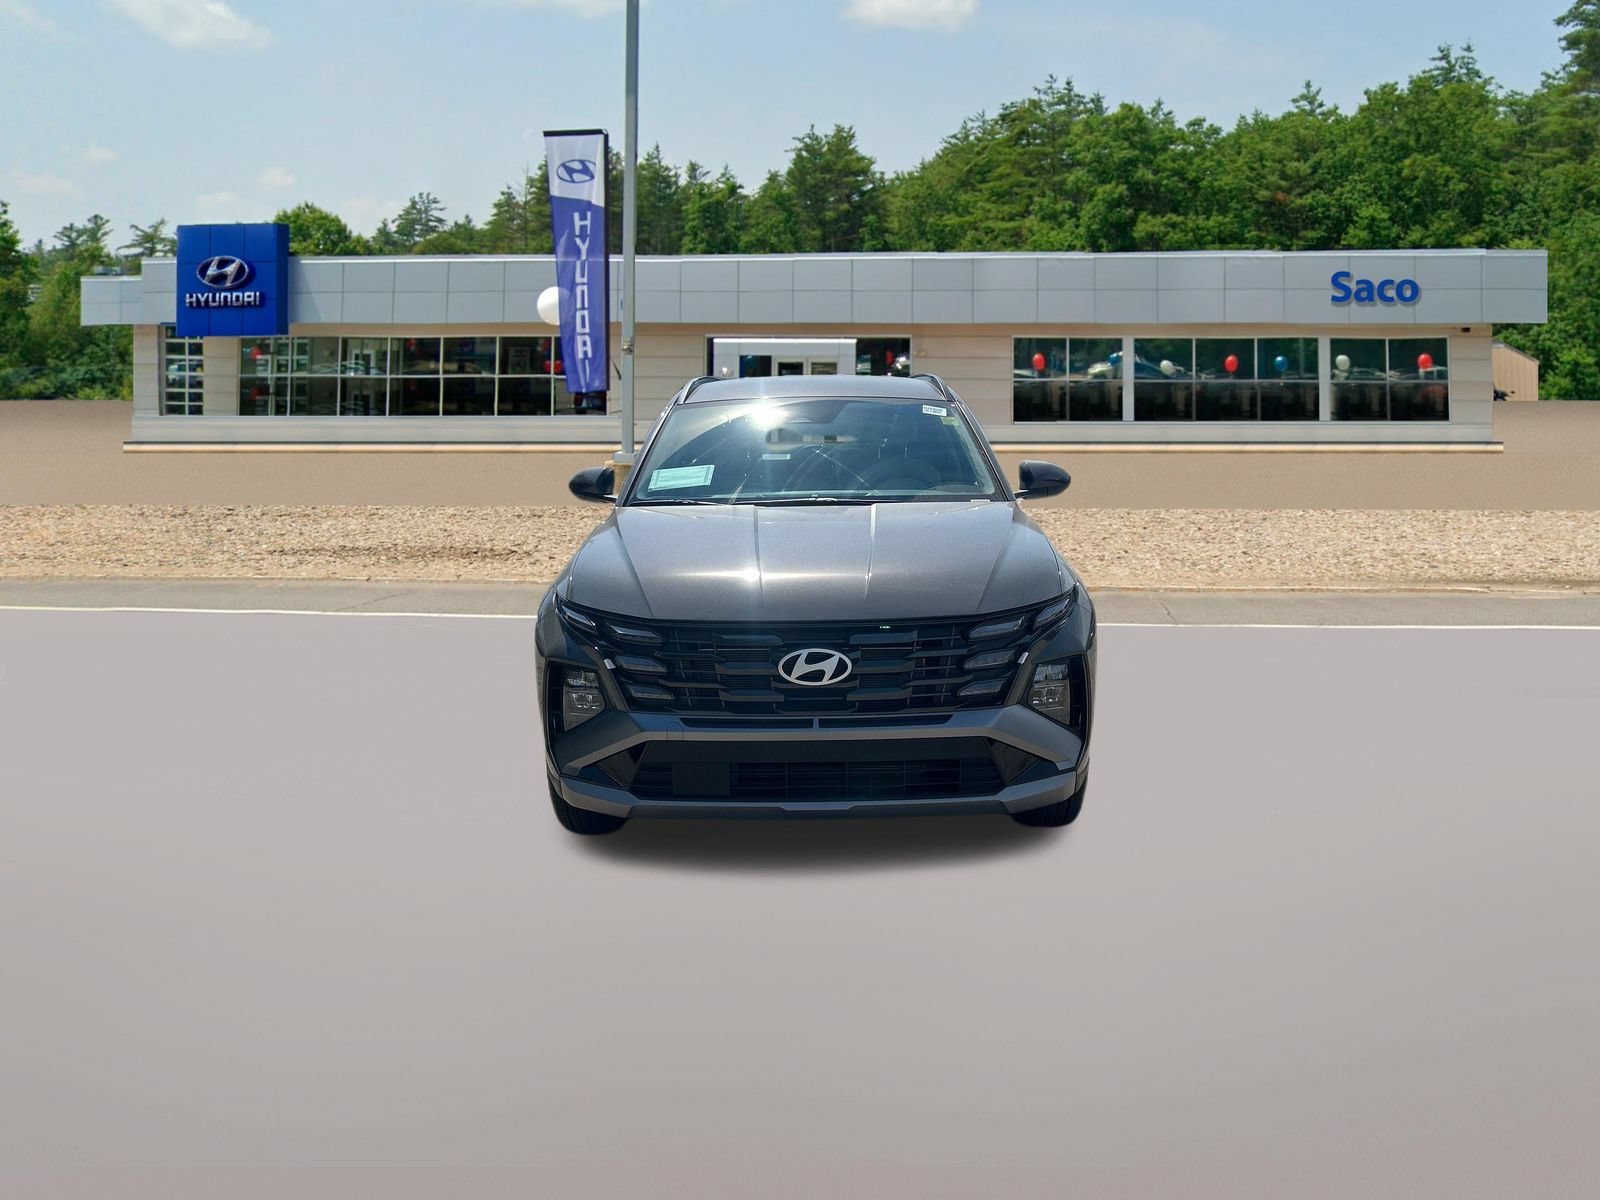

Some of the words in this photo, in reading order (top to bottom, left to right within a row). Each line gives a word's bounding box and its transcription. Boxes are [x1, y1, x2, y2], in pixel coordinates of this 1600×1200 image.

[185, 291, 261, 307] HYUNDAI
[573, 211, 593, 383] HYUNDAI
[1330, 270, 1420, 303] Saco
